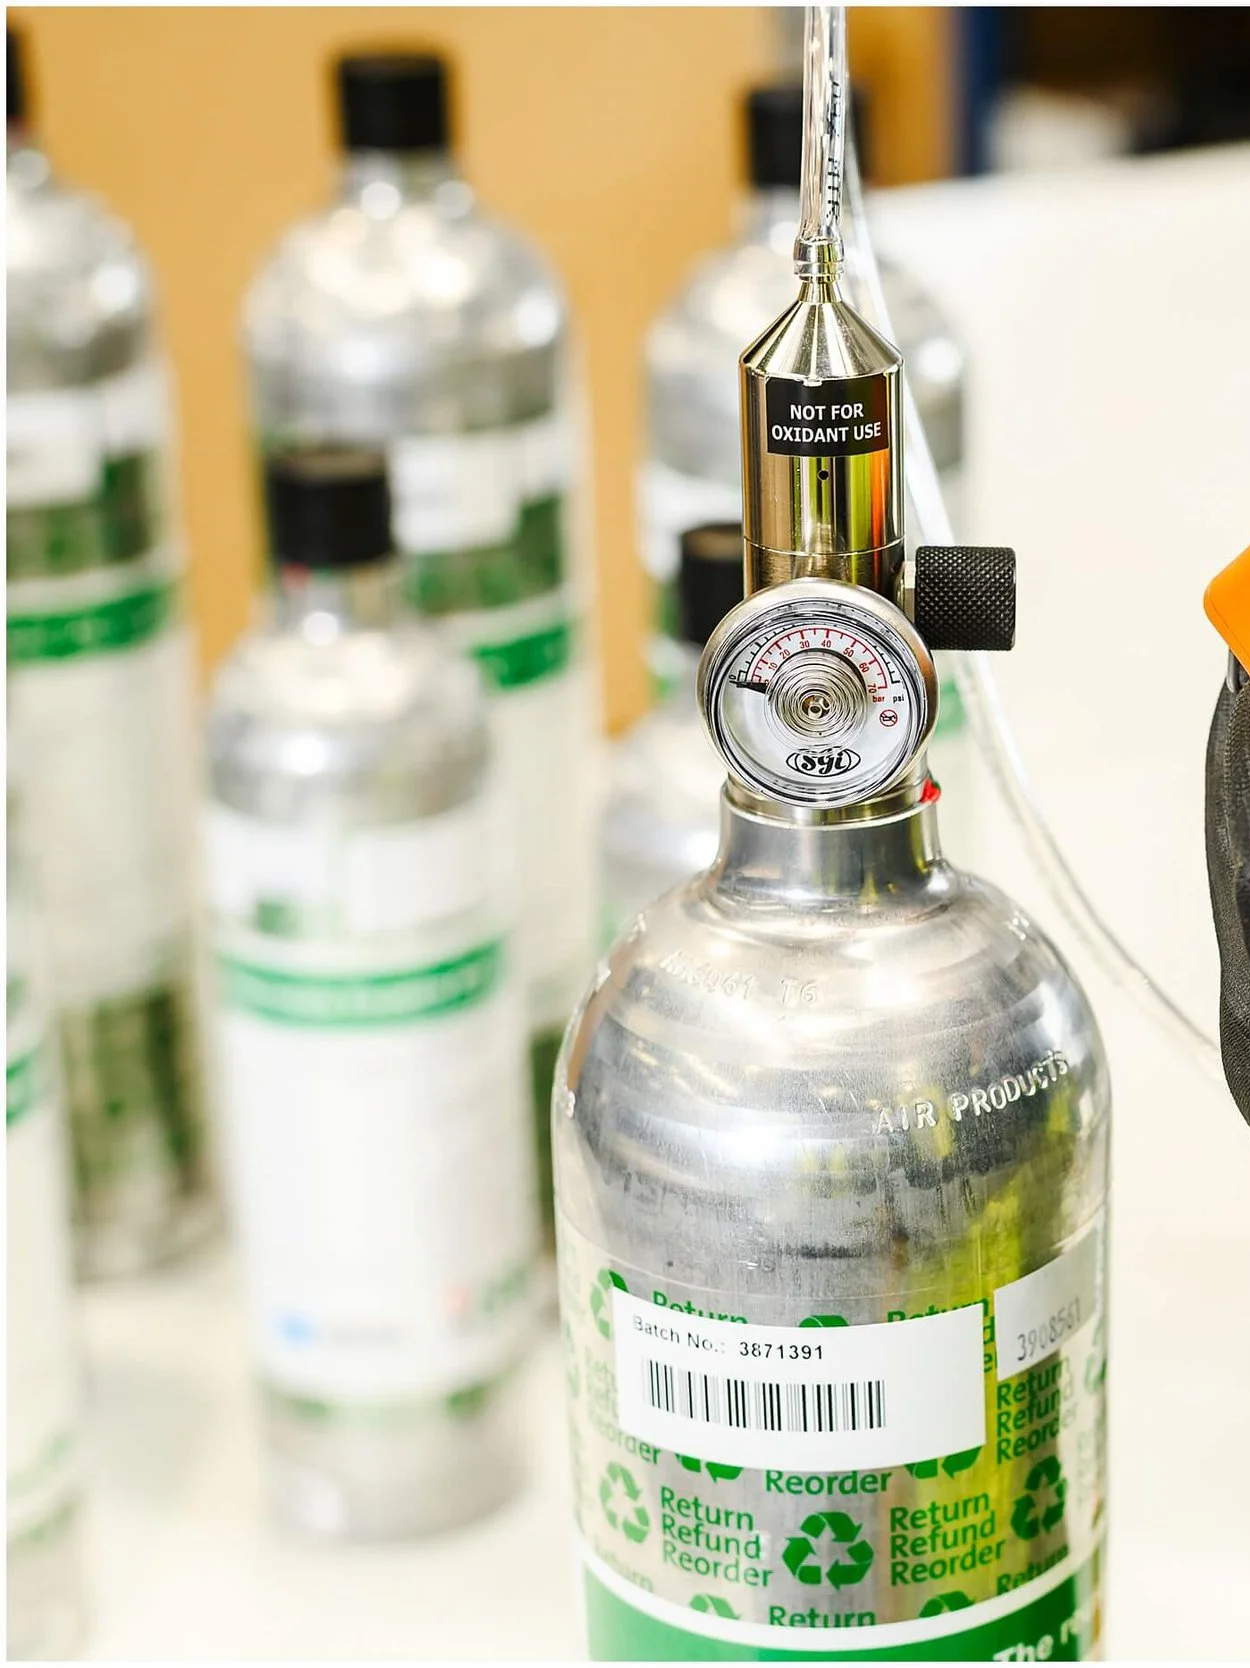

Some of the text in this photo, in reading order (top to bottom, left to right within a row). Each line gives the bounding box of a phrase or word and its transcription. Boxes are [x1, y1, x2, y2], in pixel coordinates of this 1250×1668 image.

[790, 402, 865, 421] NOT FOR
[771, 421, 882, 443] OXIDANT USE
[779, 649, 791, 660] 20
[799, 640, 811, 649] 30
[821, 639, 832, 649] 40
[842, 647, 855, 658] 50
[768, 662, 778, 671] 10
[858, 662, 870, 673] 60
[867, 683, 878, 695] 70
[872, 694, 905, 704] bar psi
[873, 1049, 1070, 1135] AIR PRODUCTS
[632, 1314, 681, 1345] Batch
[739, 1341, 823, 1361] 3871391
[765, 1468, 893, 1496] Reorder
[660, 1485, 755, 1532] Return
[889, 1491, 991, 1534] Return
[661, 1512, 762, 1560] Refund
[889, 1510, 996, 1560] Refund
[662, 1539, 775, 1588] Reorder
[890, 1538, 1006, 1587] Reorder
